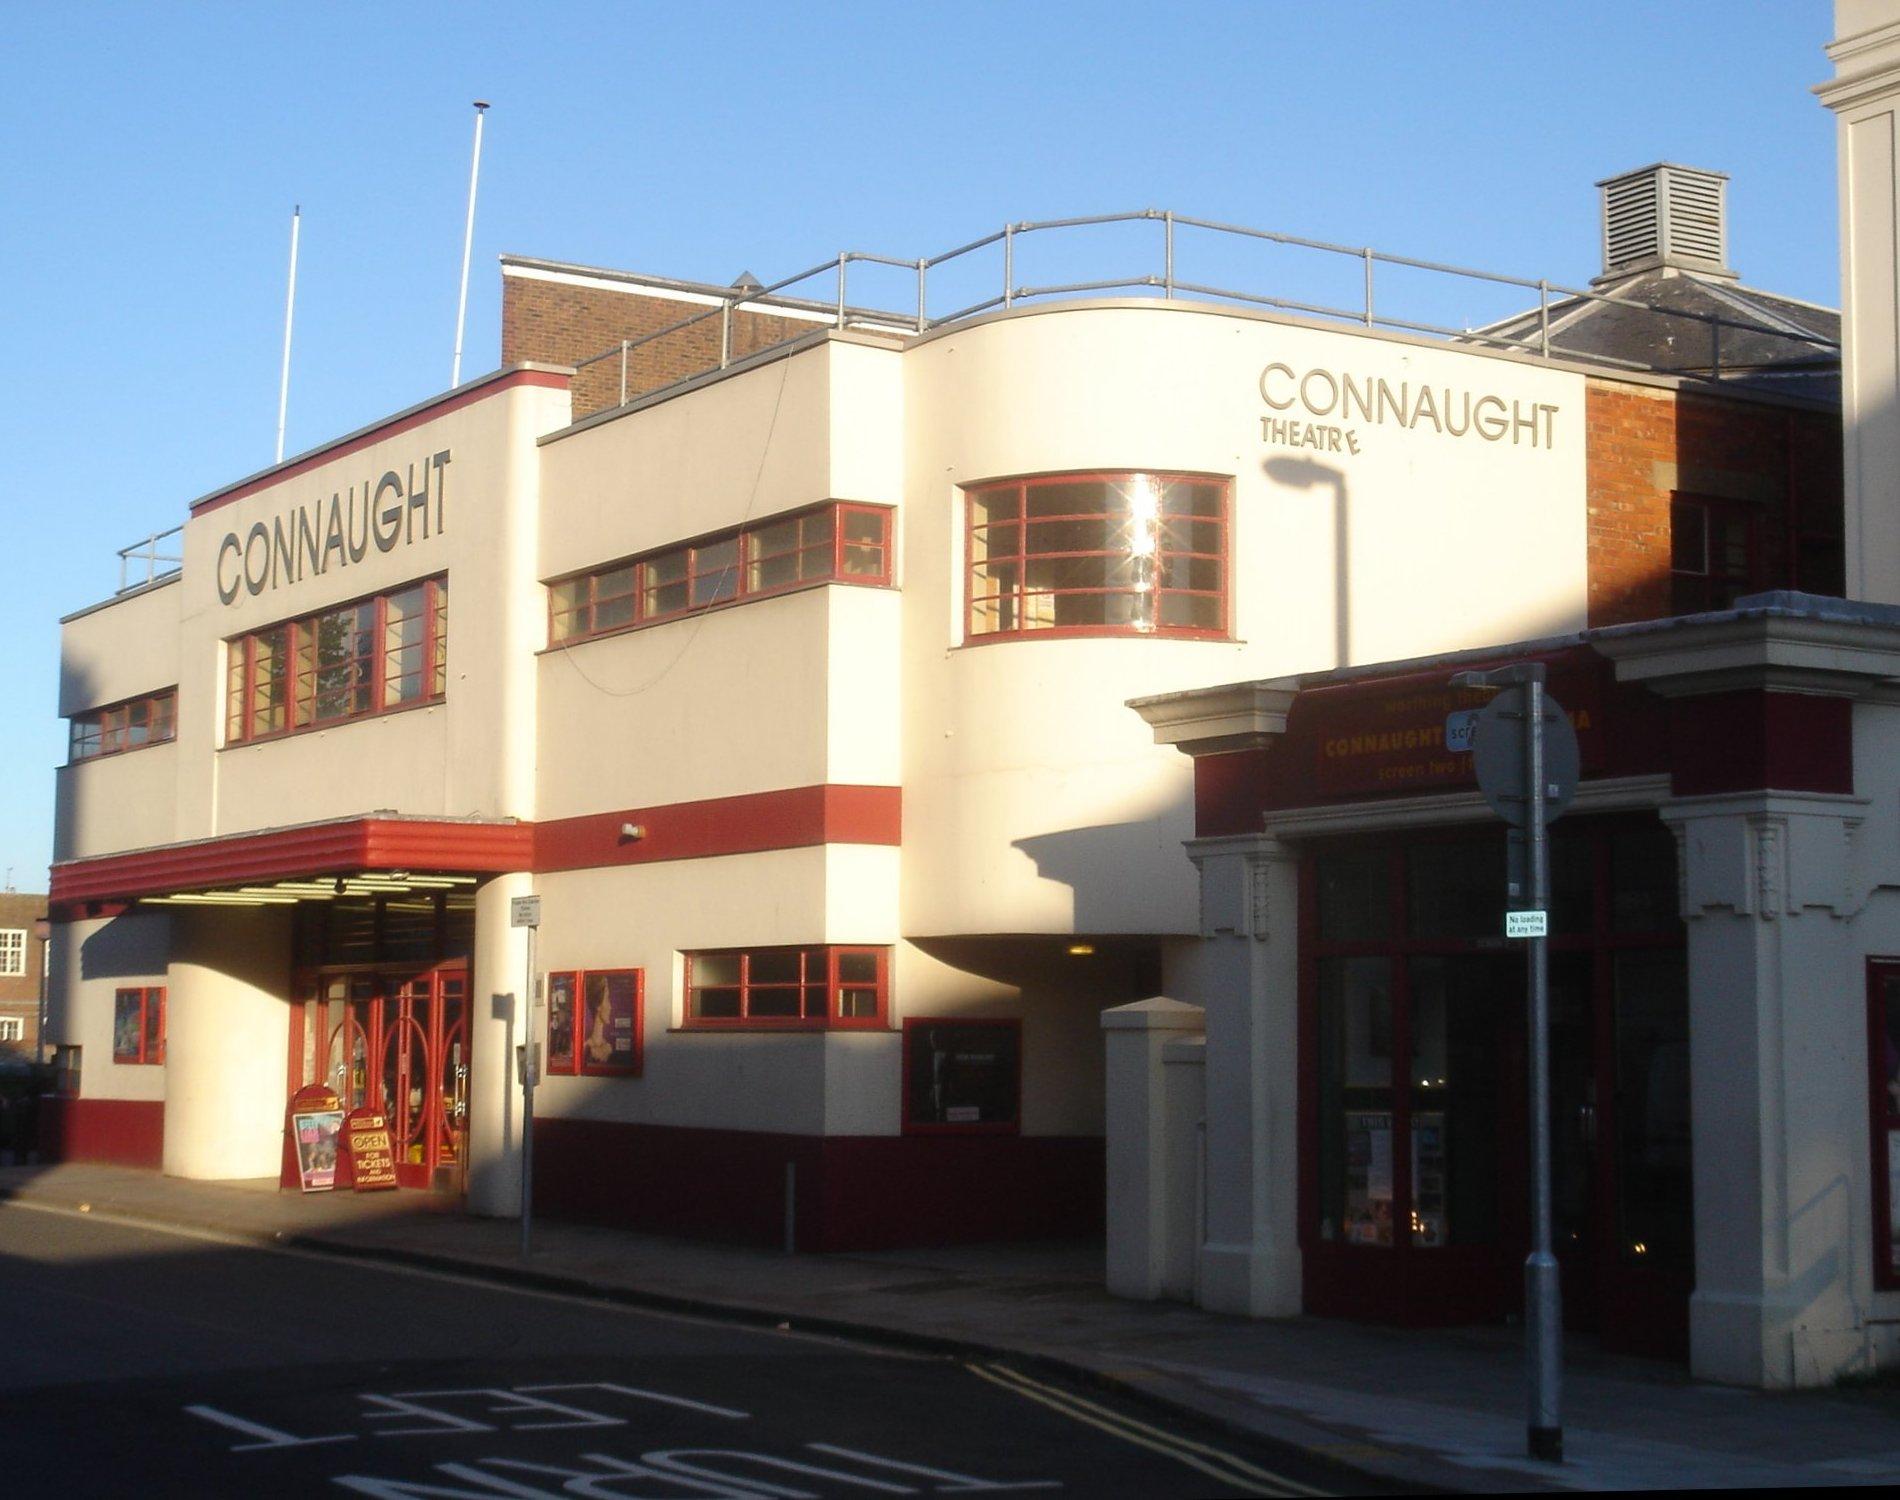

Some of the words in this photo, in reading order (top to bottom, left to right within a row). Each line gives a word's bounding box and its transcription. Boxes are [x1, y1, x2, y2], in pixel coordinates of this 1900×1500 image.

[1259, 362, 1559, 450] CONNAUGHT
[1260, 416, 1361, 456] THEATRE
[217, 448, 451, 606] CONNAUGHT
[1325, 725, 1443, 758] CONNAUGHT
[1509, 915, 1519, 924] No
[1520, 915, 1544, 924] loading
[1517, 926, 1528, 934] any
[1530, 925, 1544, 933] time
[353, 1135, 387, 1149] OPEN
[357, 1158, 391, 1170] TICKETS
